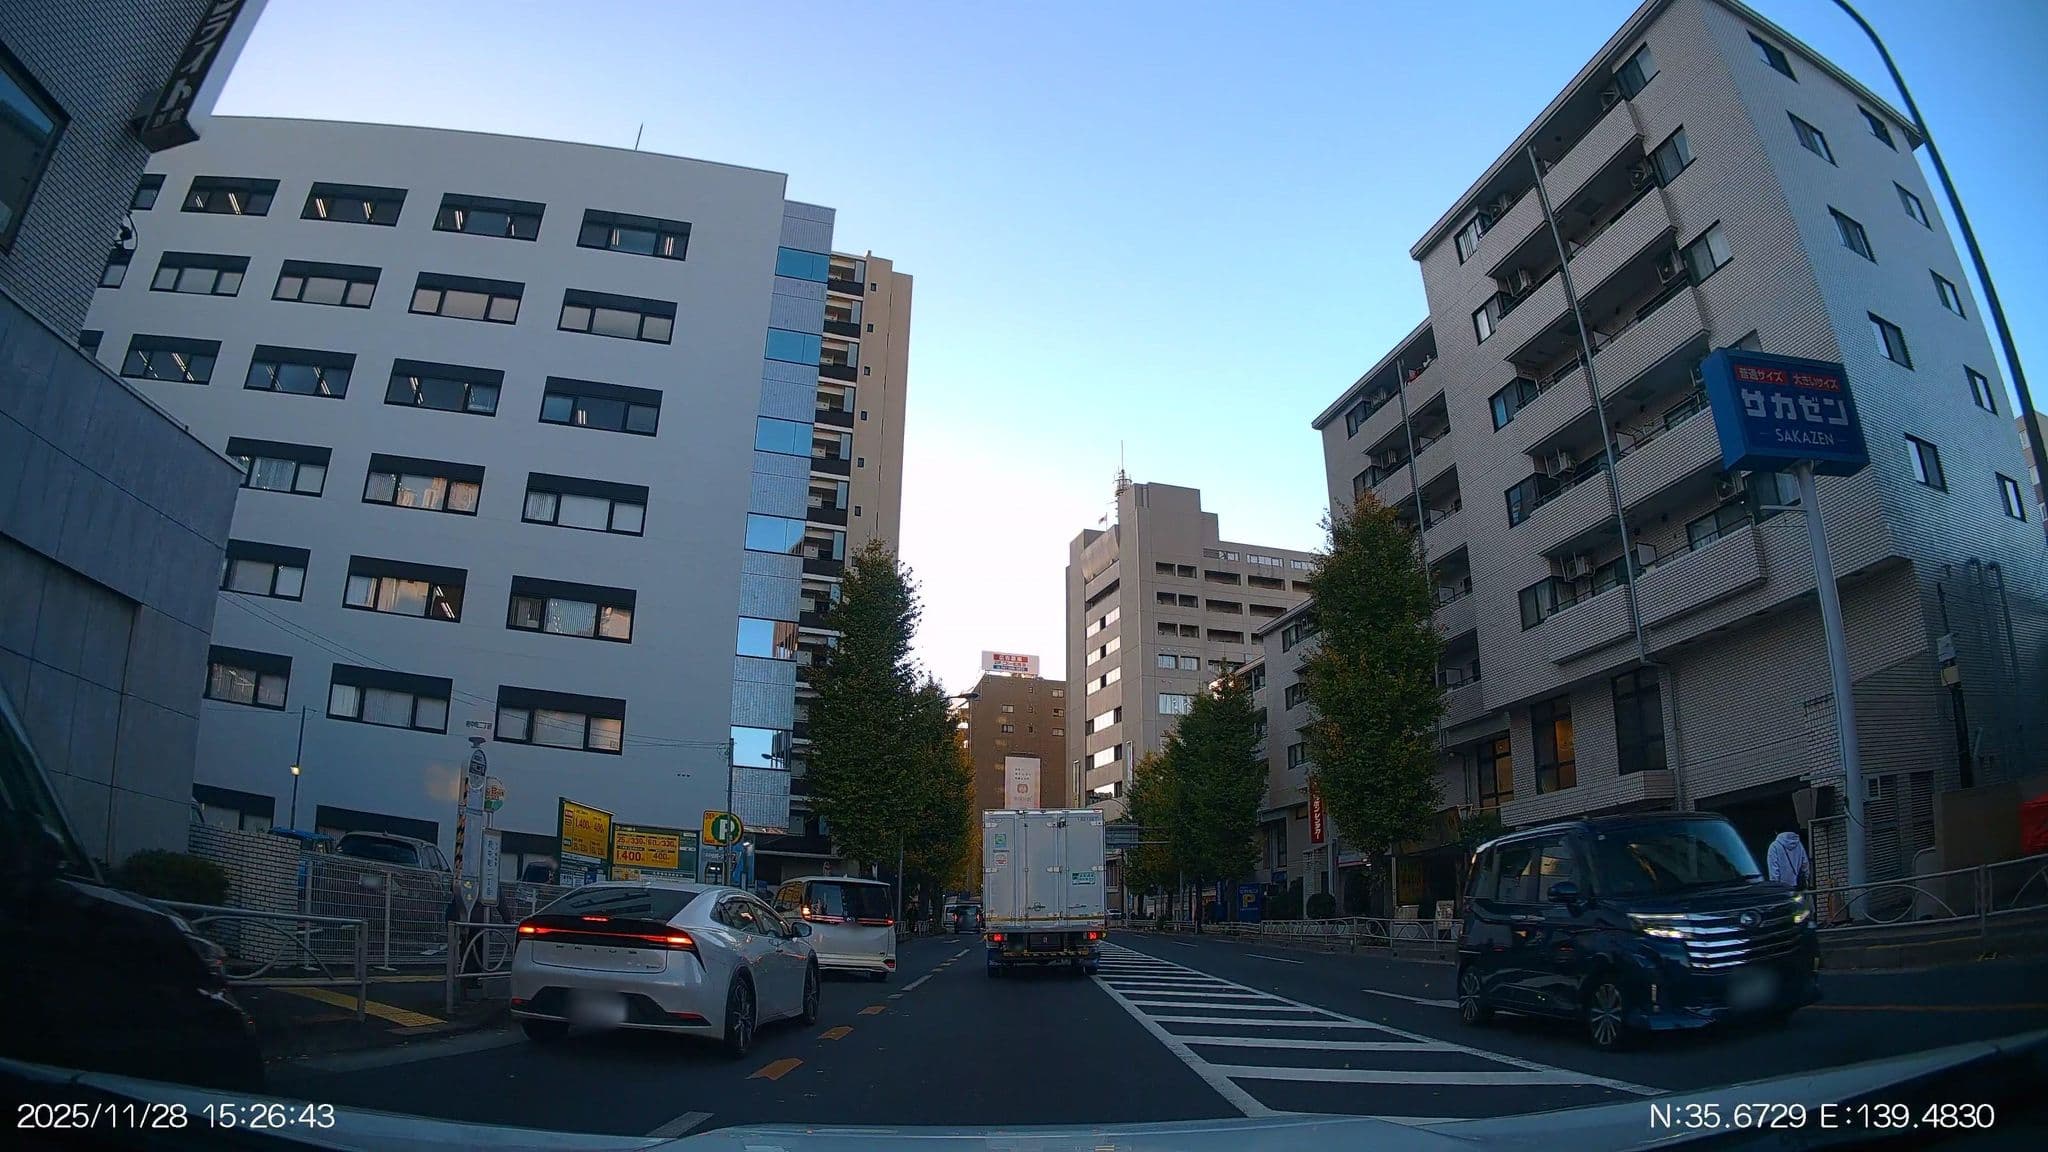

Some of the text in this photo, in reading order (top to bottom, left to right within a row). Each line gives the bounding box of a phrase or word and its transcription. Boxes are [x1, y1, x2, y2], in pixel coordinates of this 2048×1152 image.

[1739, 367, 1839, 390] 普通サイズ 大きいサイズ
[1741, 388, 1849, 426] サカゼン
[1775, 428, 1835, 446] SAKAZEN
[719, 819, 736, 840] P
[1243, 894, 1256, 908] P
